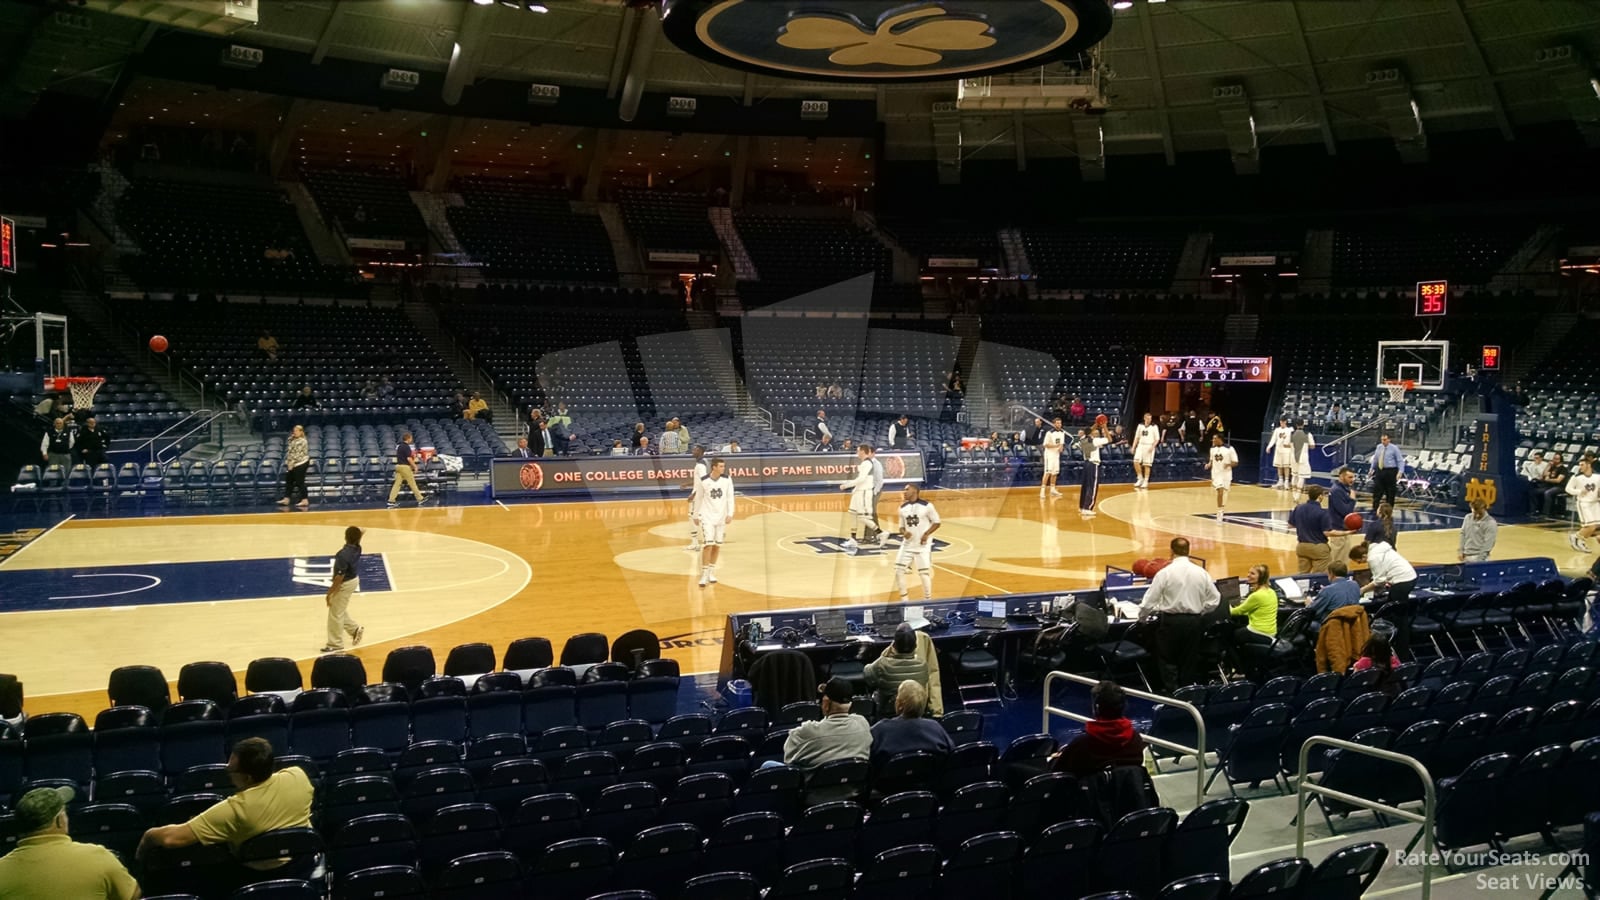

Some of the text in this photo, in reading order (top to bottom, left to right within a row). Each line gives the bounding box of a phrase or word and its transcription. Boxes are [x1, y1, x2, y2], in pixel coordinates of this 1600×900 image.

[1421, 284, 1445, 296] 35:33
[1423, 295, 1441, 312] 35
[1193, 358, 1221, 367] 35:33
[1155, 365, 1163, 375] 0
[1252, 366, 1260, 376] 0
[1479, 423, 1490, 471] IRISH
[553, 462, 860, 483] ONE COLLEGE BASKET HALL OF FAME INDUCT
